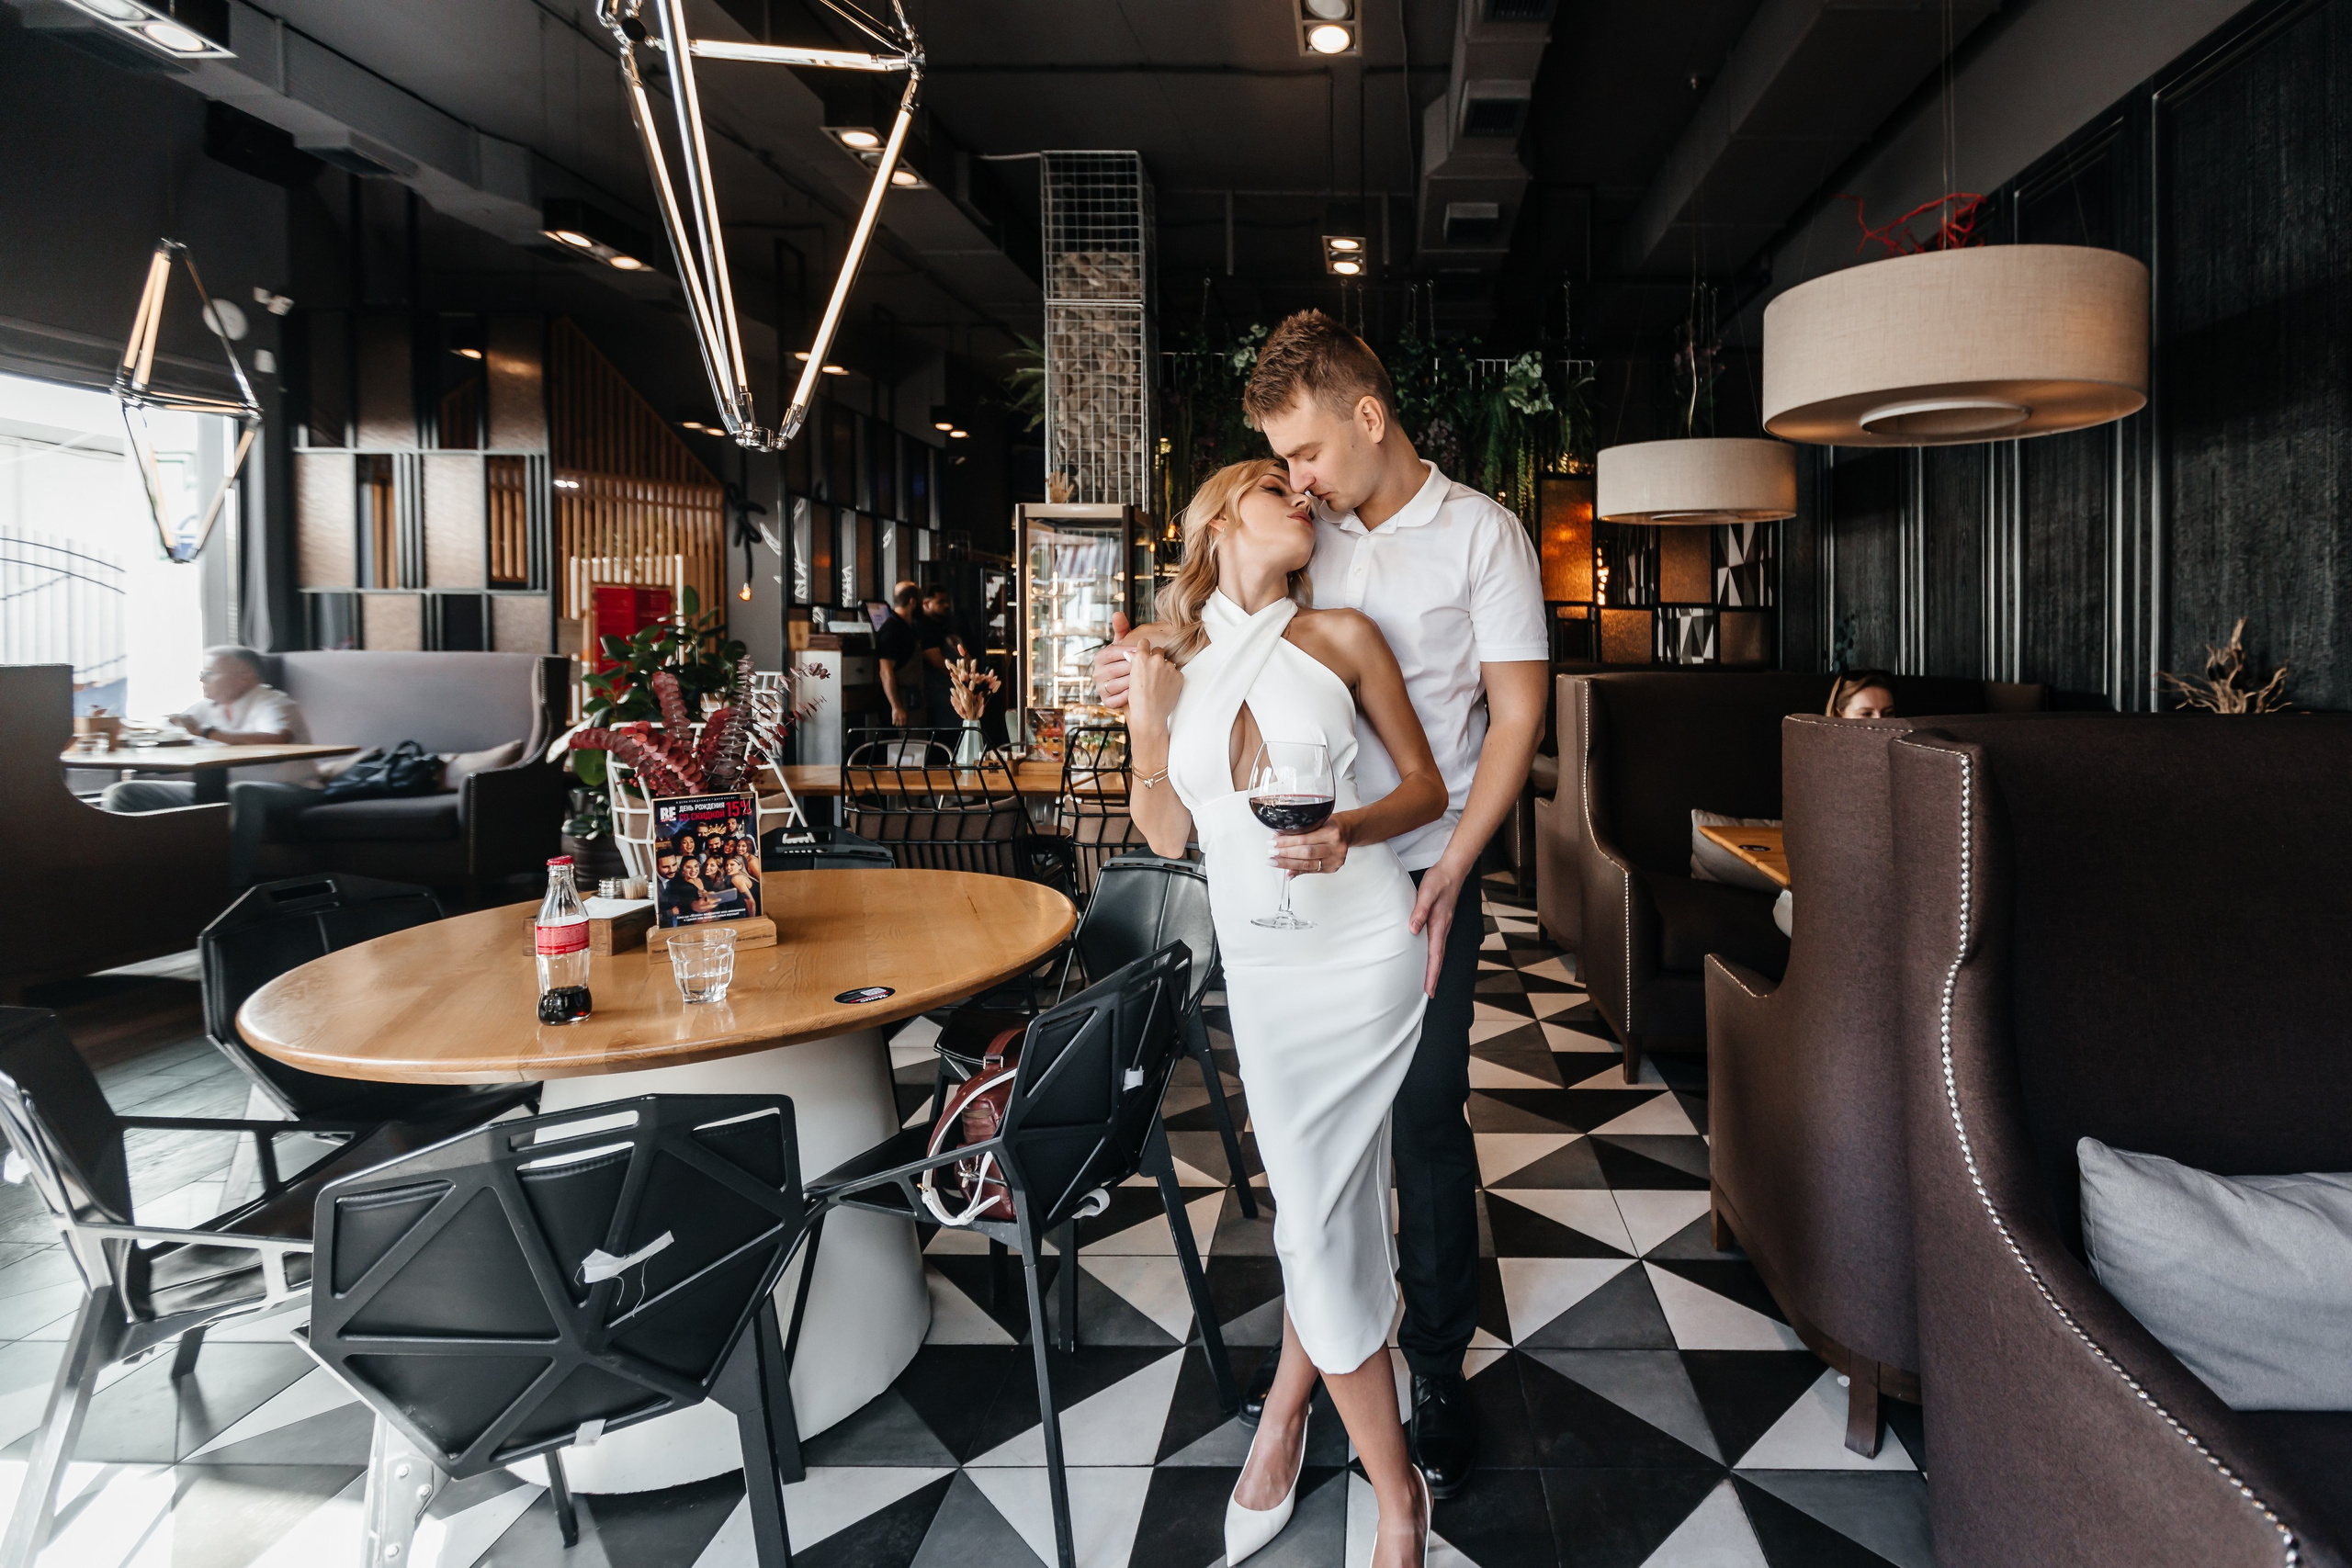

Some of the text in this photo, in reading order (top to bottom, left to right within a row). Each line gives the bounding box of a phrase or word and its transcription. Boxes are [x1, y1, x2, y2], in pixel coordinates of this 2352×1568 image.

[679, 802, 725, 813] ДЕНЬ РОЖДЕНИЯ
[679, 809, 725, 822] СО СКИДКОЙ
